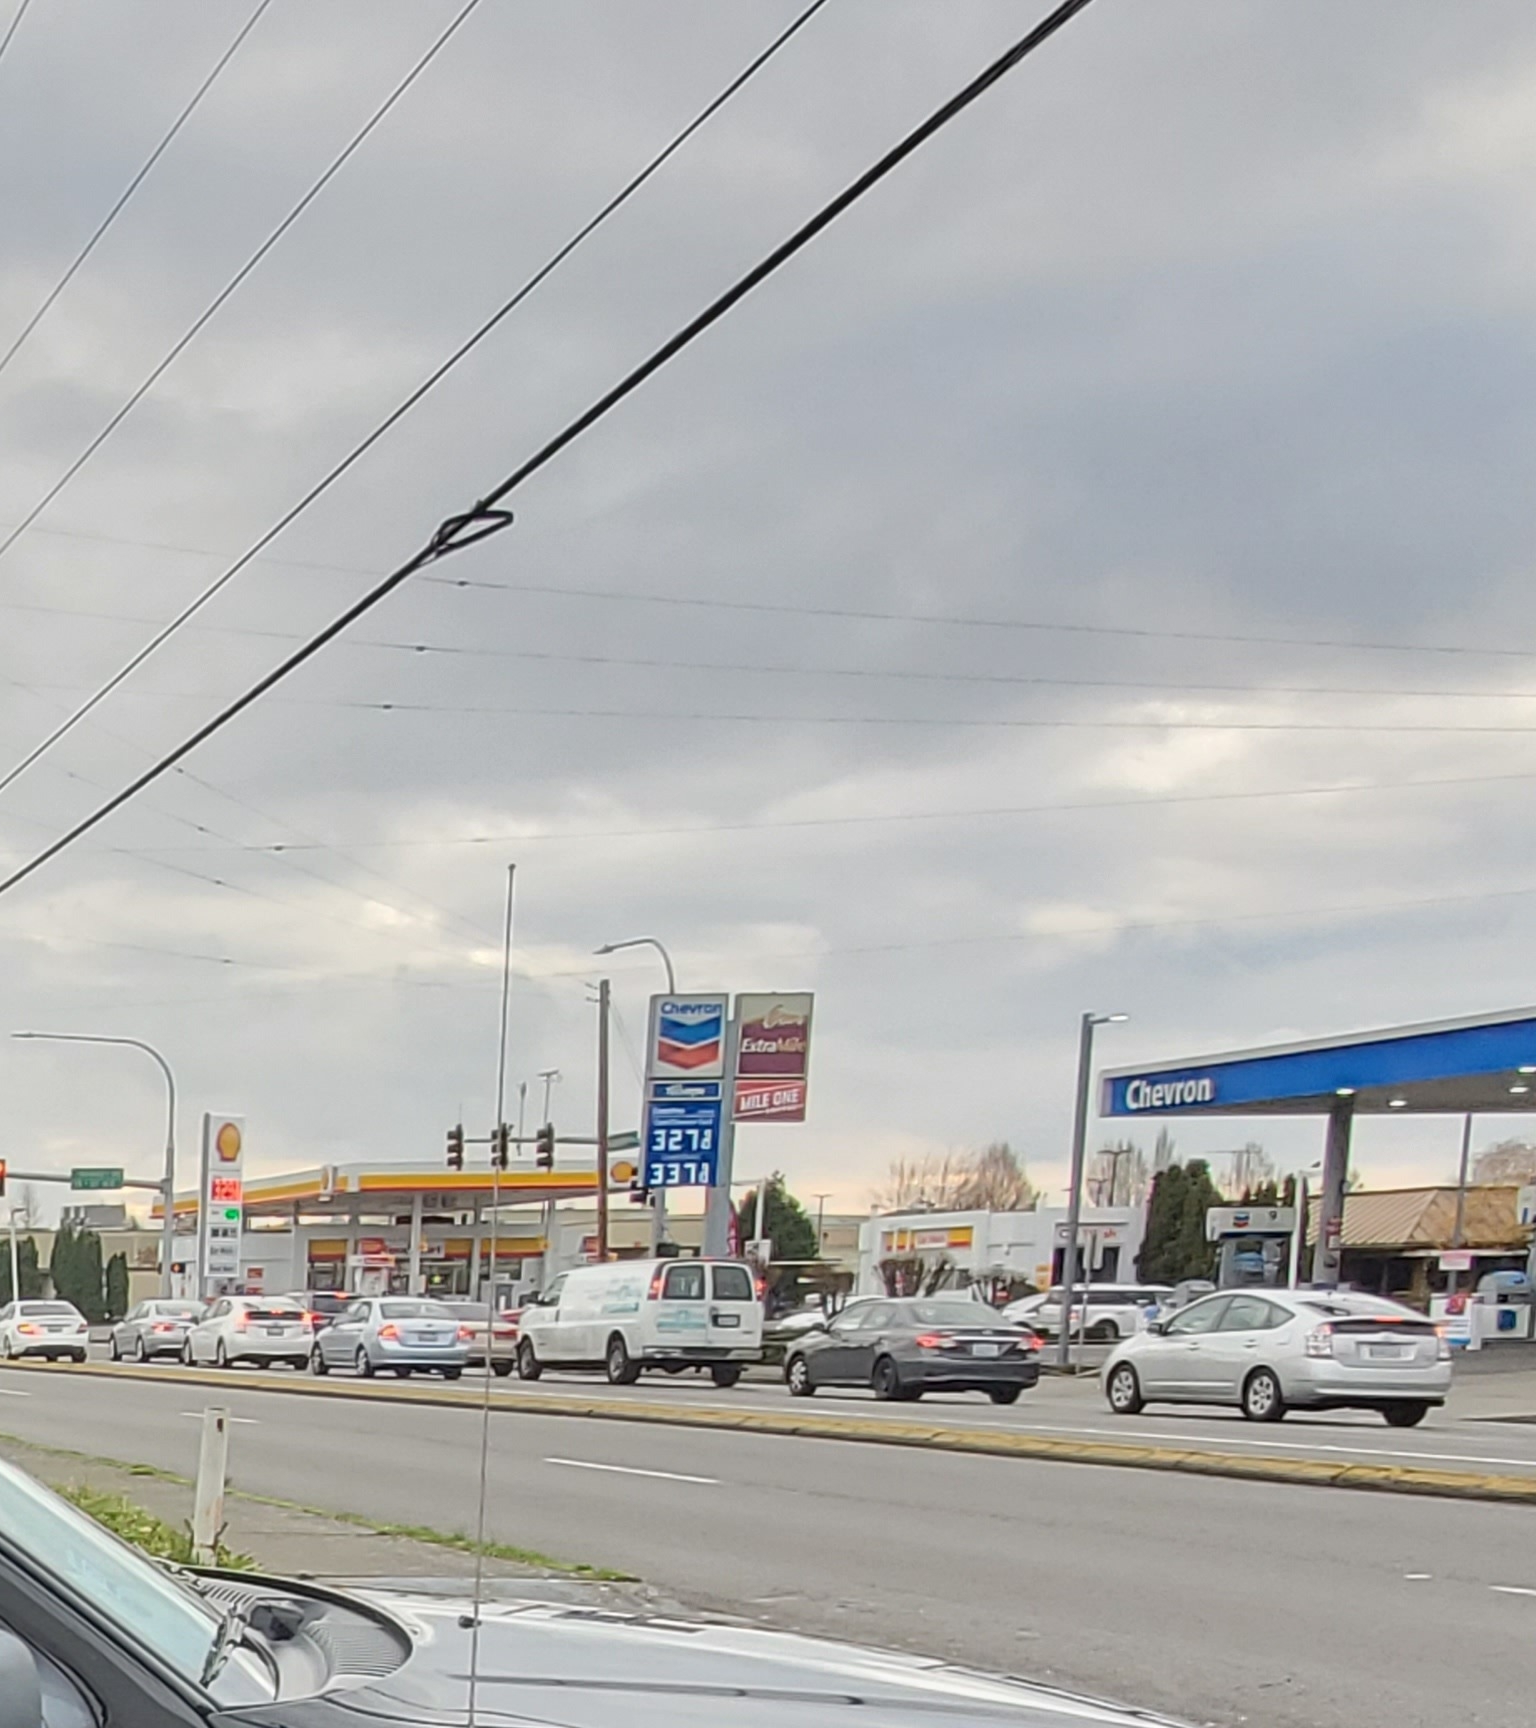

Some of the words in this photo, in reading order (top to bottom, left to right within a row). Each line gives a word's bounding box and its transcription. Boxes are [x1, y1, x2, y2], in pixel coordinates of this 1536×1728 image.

[661, 1002, 722, 1015] Chevron
[741, 1094, 770, 1110] MILE
[773, 1089, 799, 1105] ONE
[1126, 1078, 1211, 1109] Chevron
